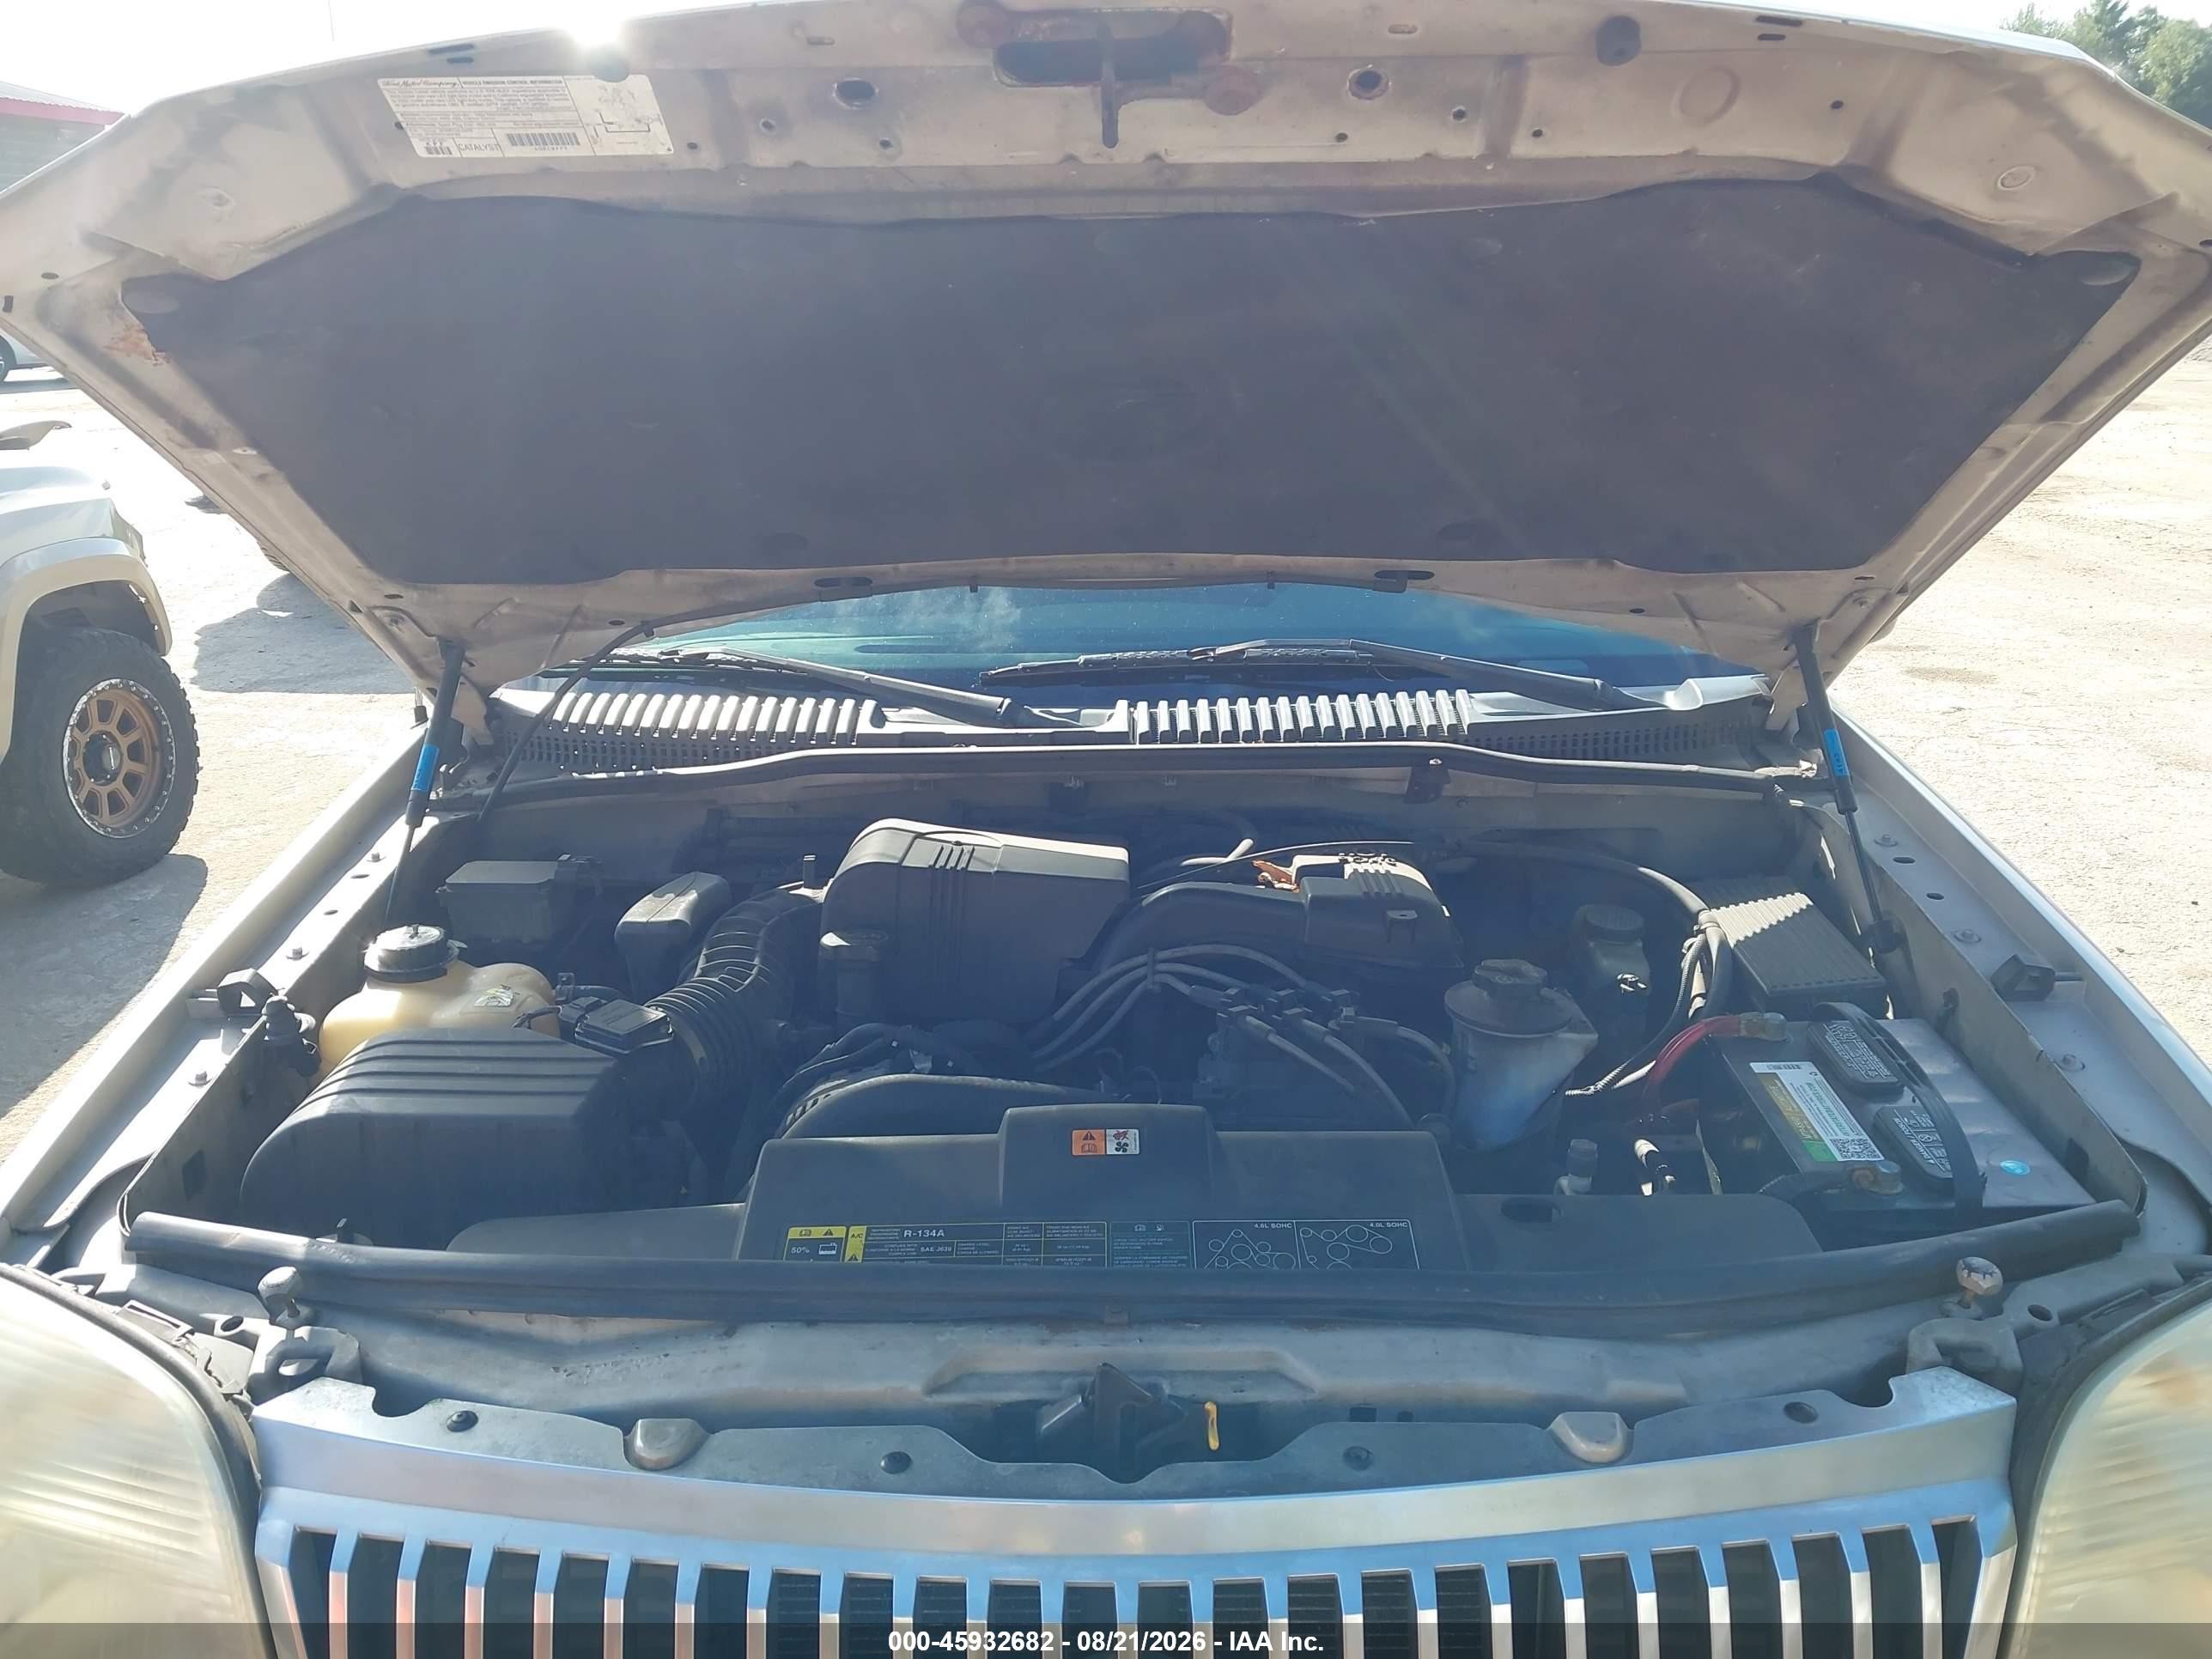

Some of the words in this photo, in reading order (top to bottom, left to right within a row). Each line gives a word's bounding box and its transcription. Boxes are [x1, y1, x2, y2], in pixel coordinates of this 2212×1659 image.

[458, 143, 501, 152] CATALYST
[902, 1229, 945, 1238] R-134A
[791, 1245, 811, 1255] 50%
